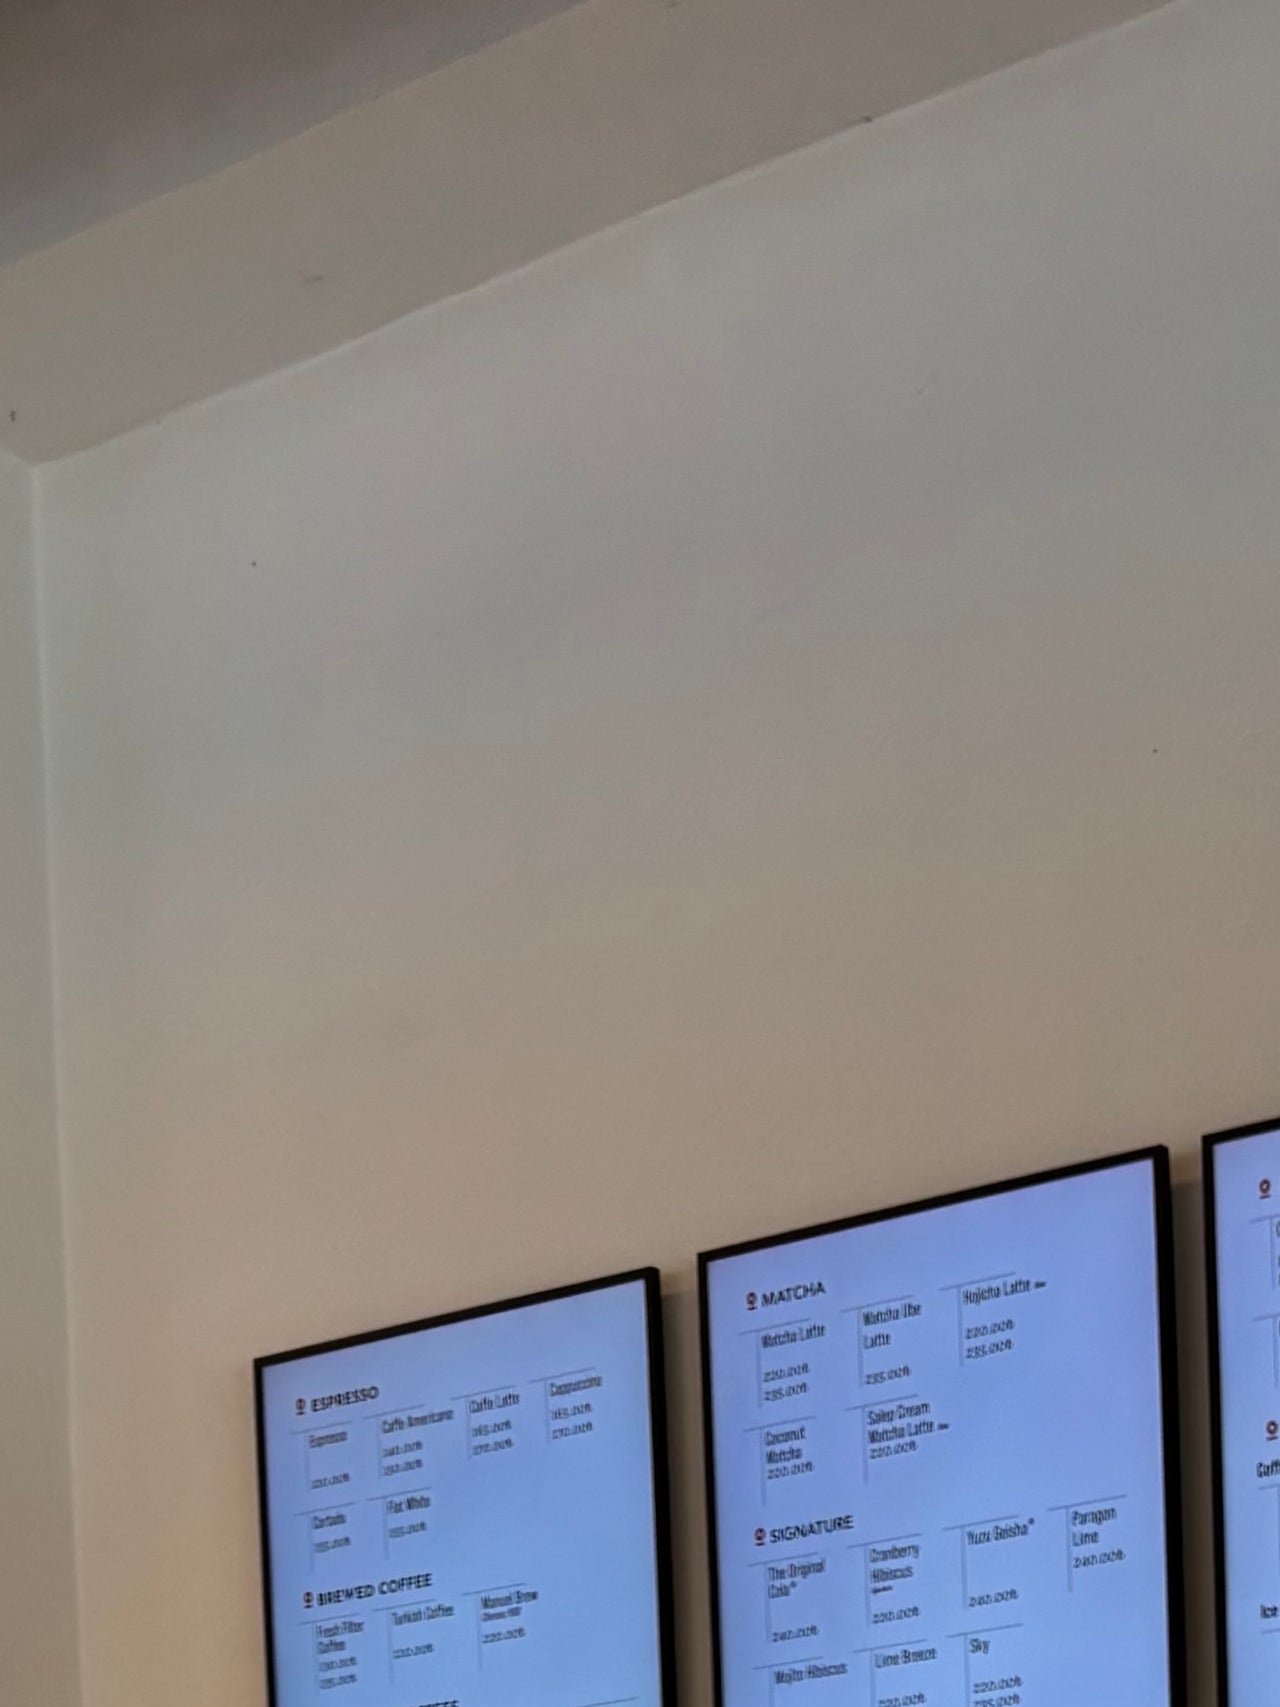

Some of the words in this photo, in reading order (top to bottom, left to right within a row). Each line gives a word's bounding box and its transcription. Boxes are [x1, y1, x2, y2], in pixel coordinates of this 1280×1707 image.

[761, 1280, 827, 1309] MATCHA
[311, 1385, 380, 1413] ESPRESSO
[769, 1514, 855, 1544] SIGNATURE
[378, 1573, 433, 1596] COFFEE
